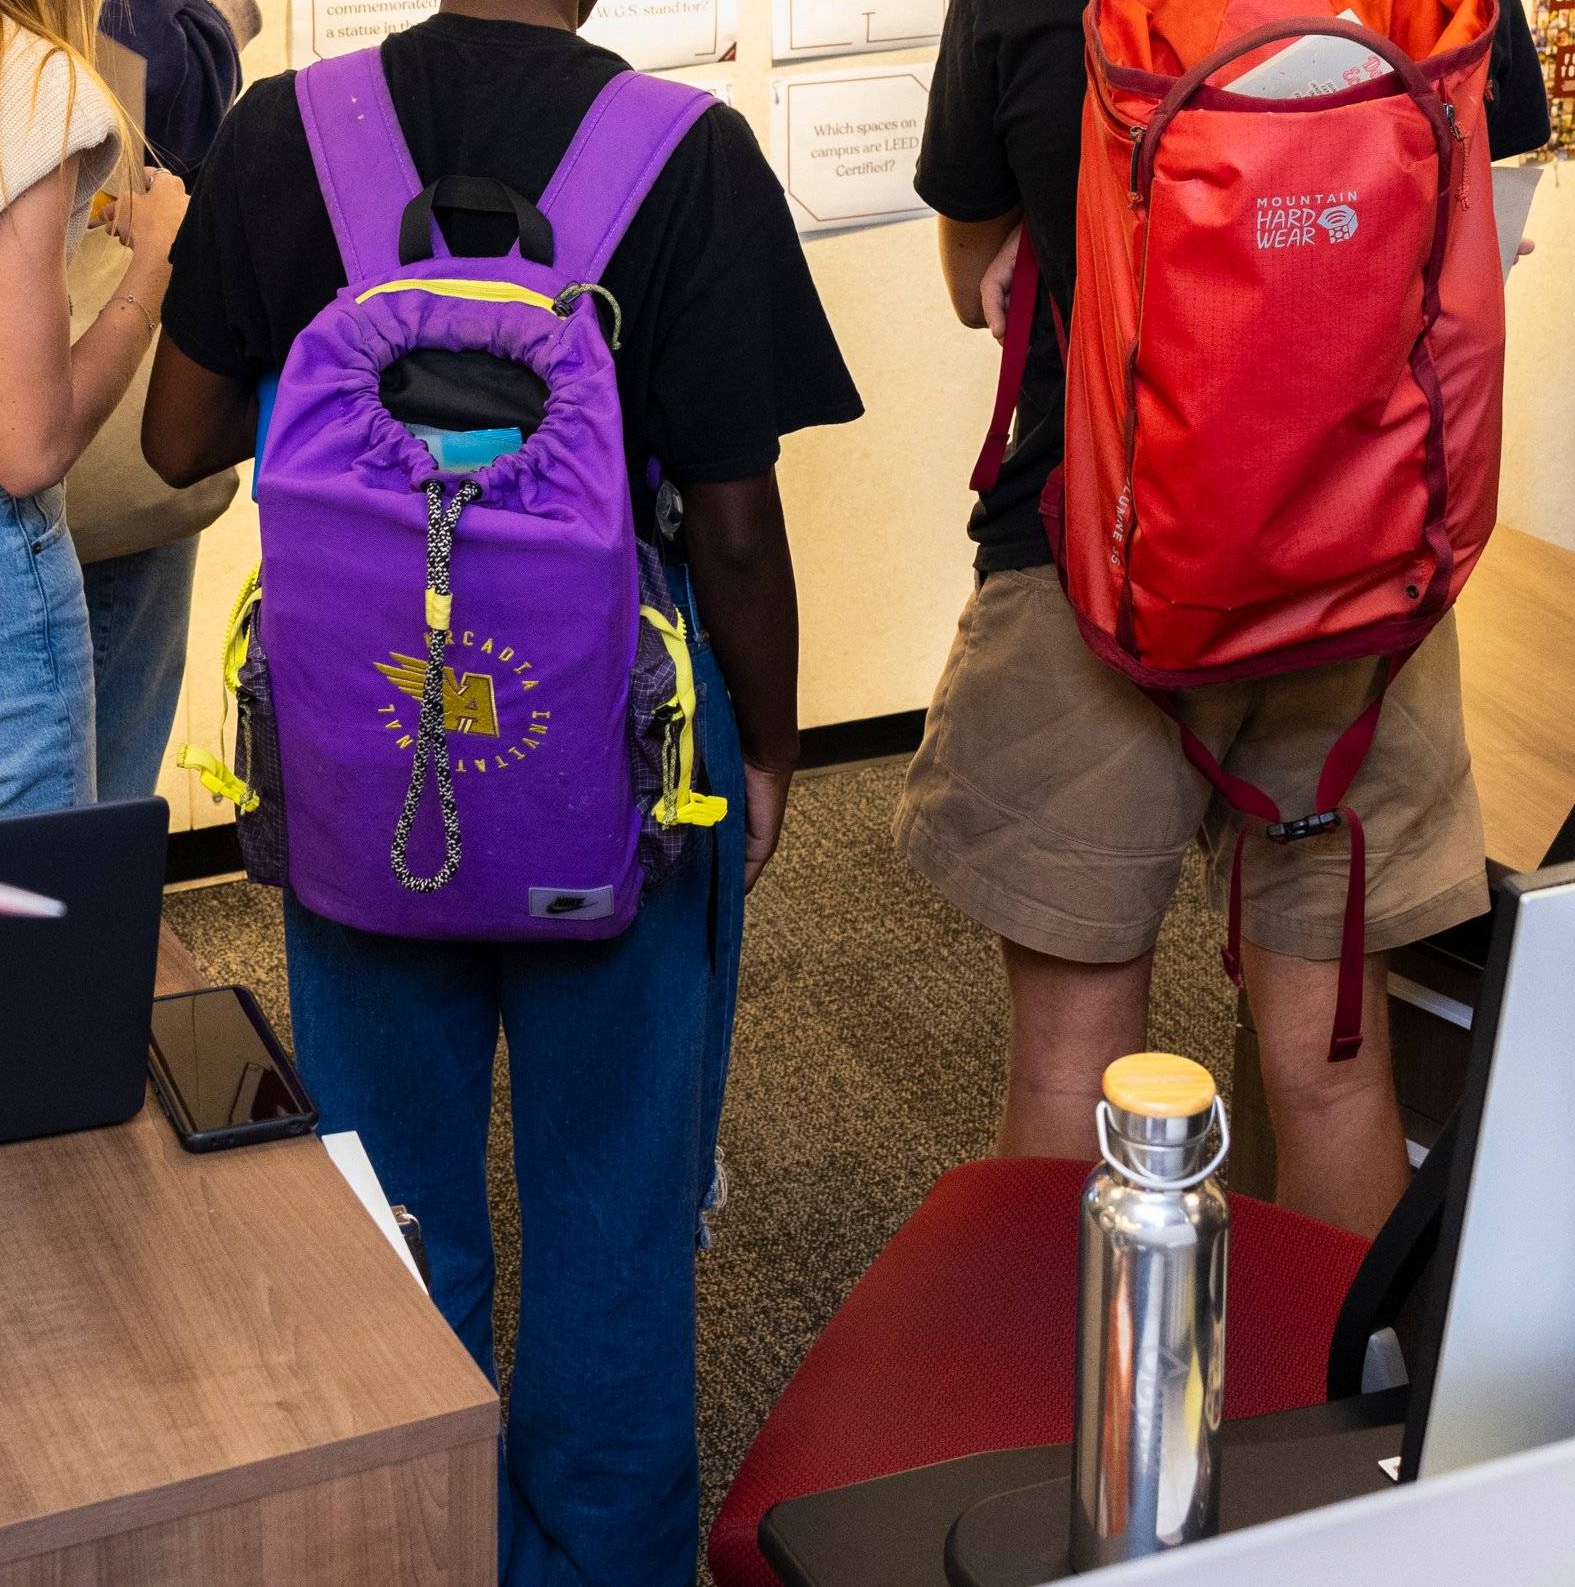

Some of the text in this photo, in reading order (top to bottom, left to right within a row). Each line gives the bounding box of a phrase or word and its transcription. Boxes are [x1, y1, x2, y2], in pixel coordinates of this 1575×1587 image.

[338, 22, 381, 38] statue
[814, 119, 916, 136] Which spaces on
[810, 136, 919, 159] campus are LEED
[836, 160, 895, 177] Certified?
[1257, 191, 1358, 207] MOUNTAIN
[1257, 208, 1316, 229] HARD
[1257, 227, 1316, 249] WEAR
